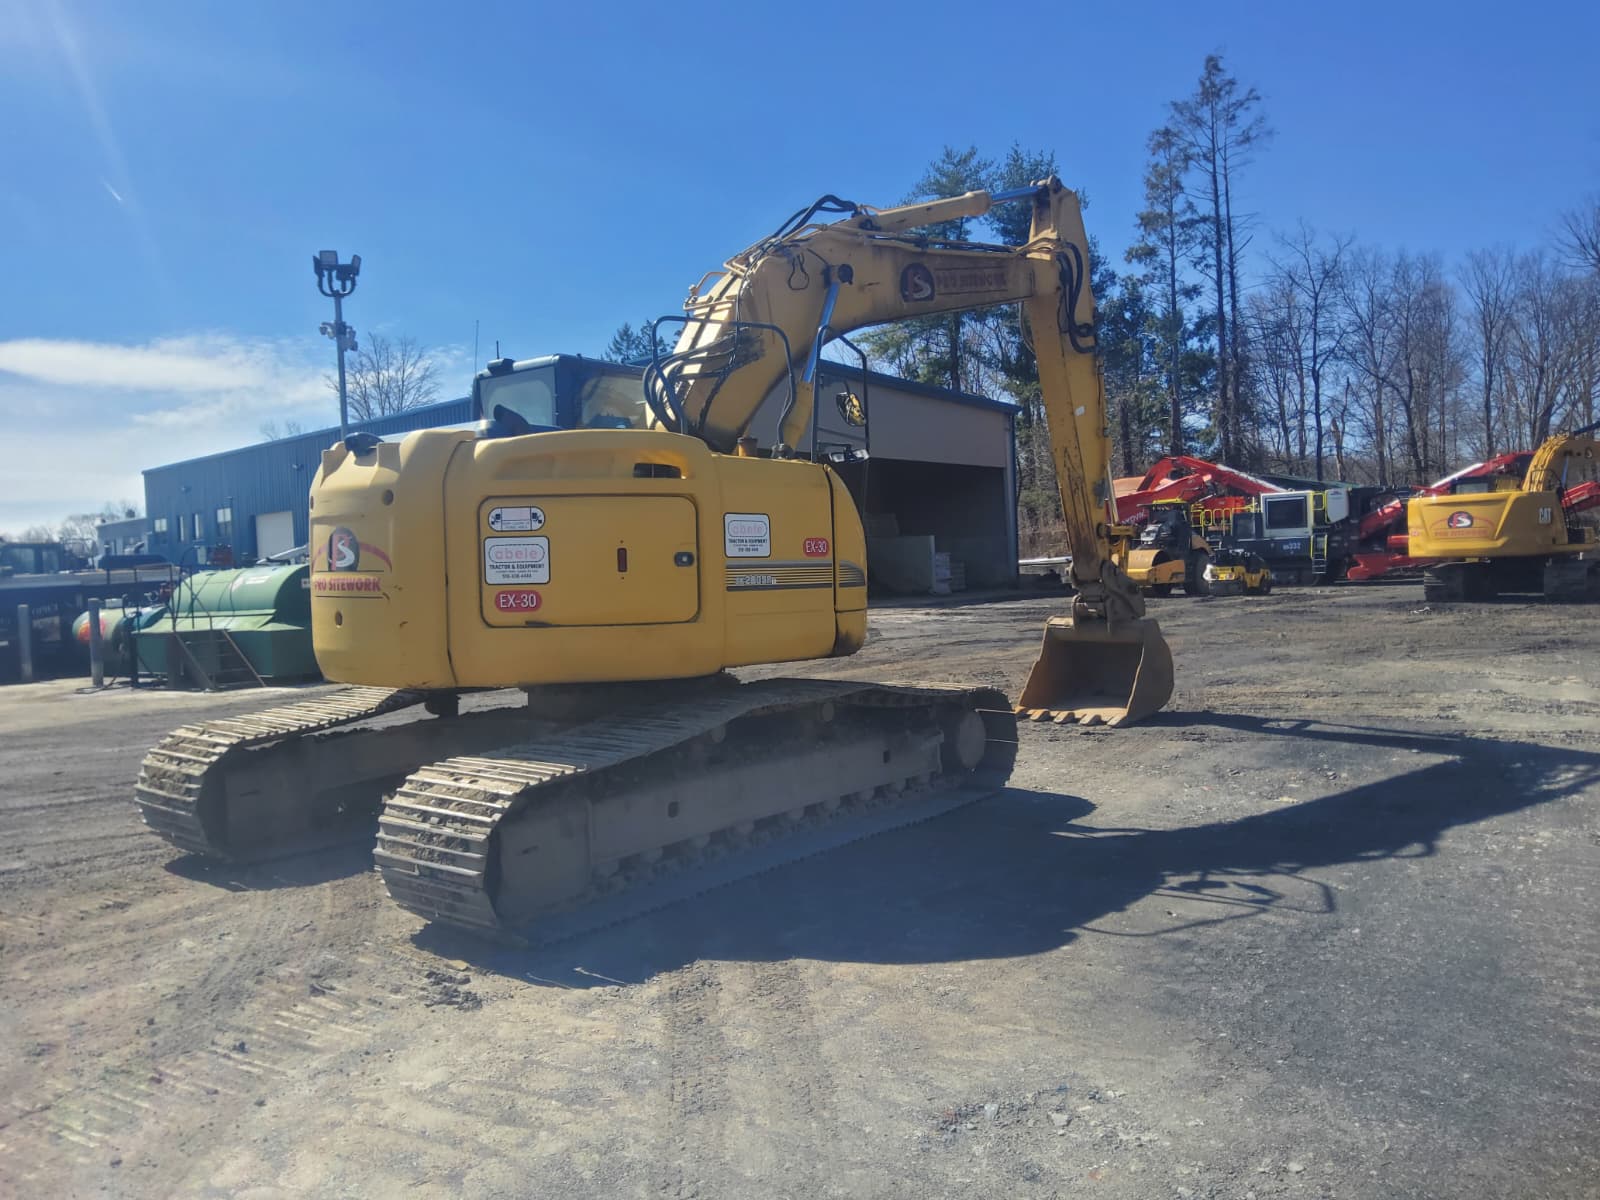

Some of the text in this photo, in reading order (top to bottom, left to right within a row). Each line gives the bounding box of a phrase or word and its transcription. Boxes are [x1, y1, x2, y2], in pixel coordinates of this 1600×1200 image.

[1539, 508, 1552, 524] CAT
[495, 547, 538, 560] abele
[805, 540, 827, 553] EX-30
[328, 576, 381, 592] SITEWORK
[499, 593, 537, 608] EX-30
